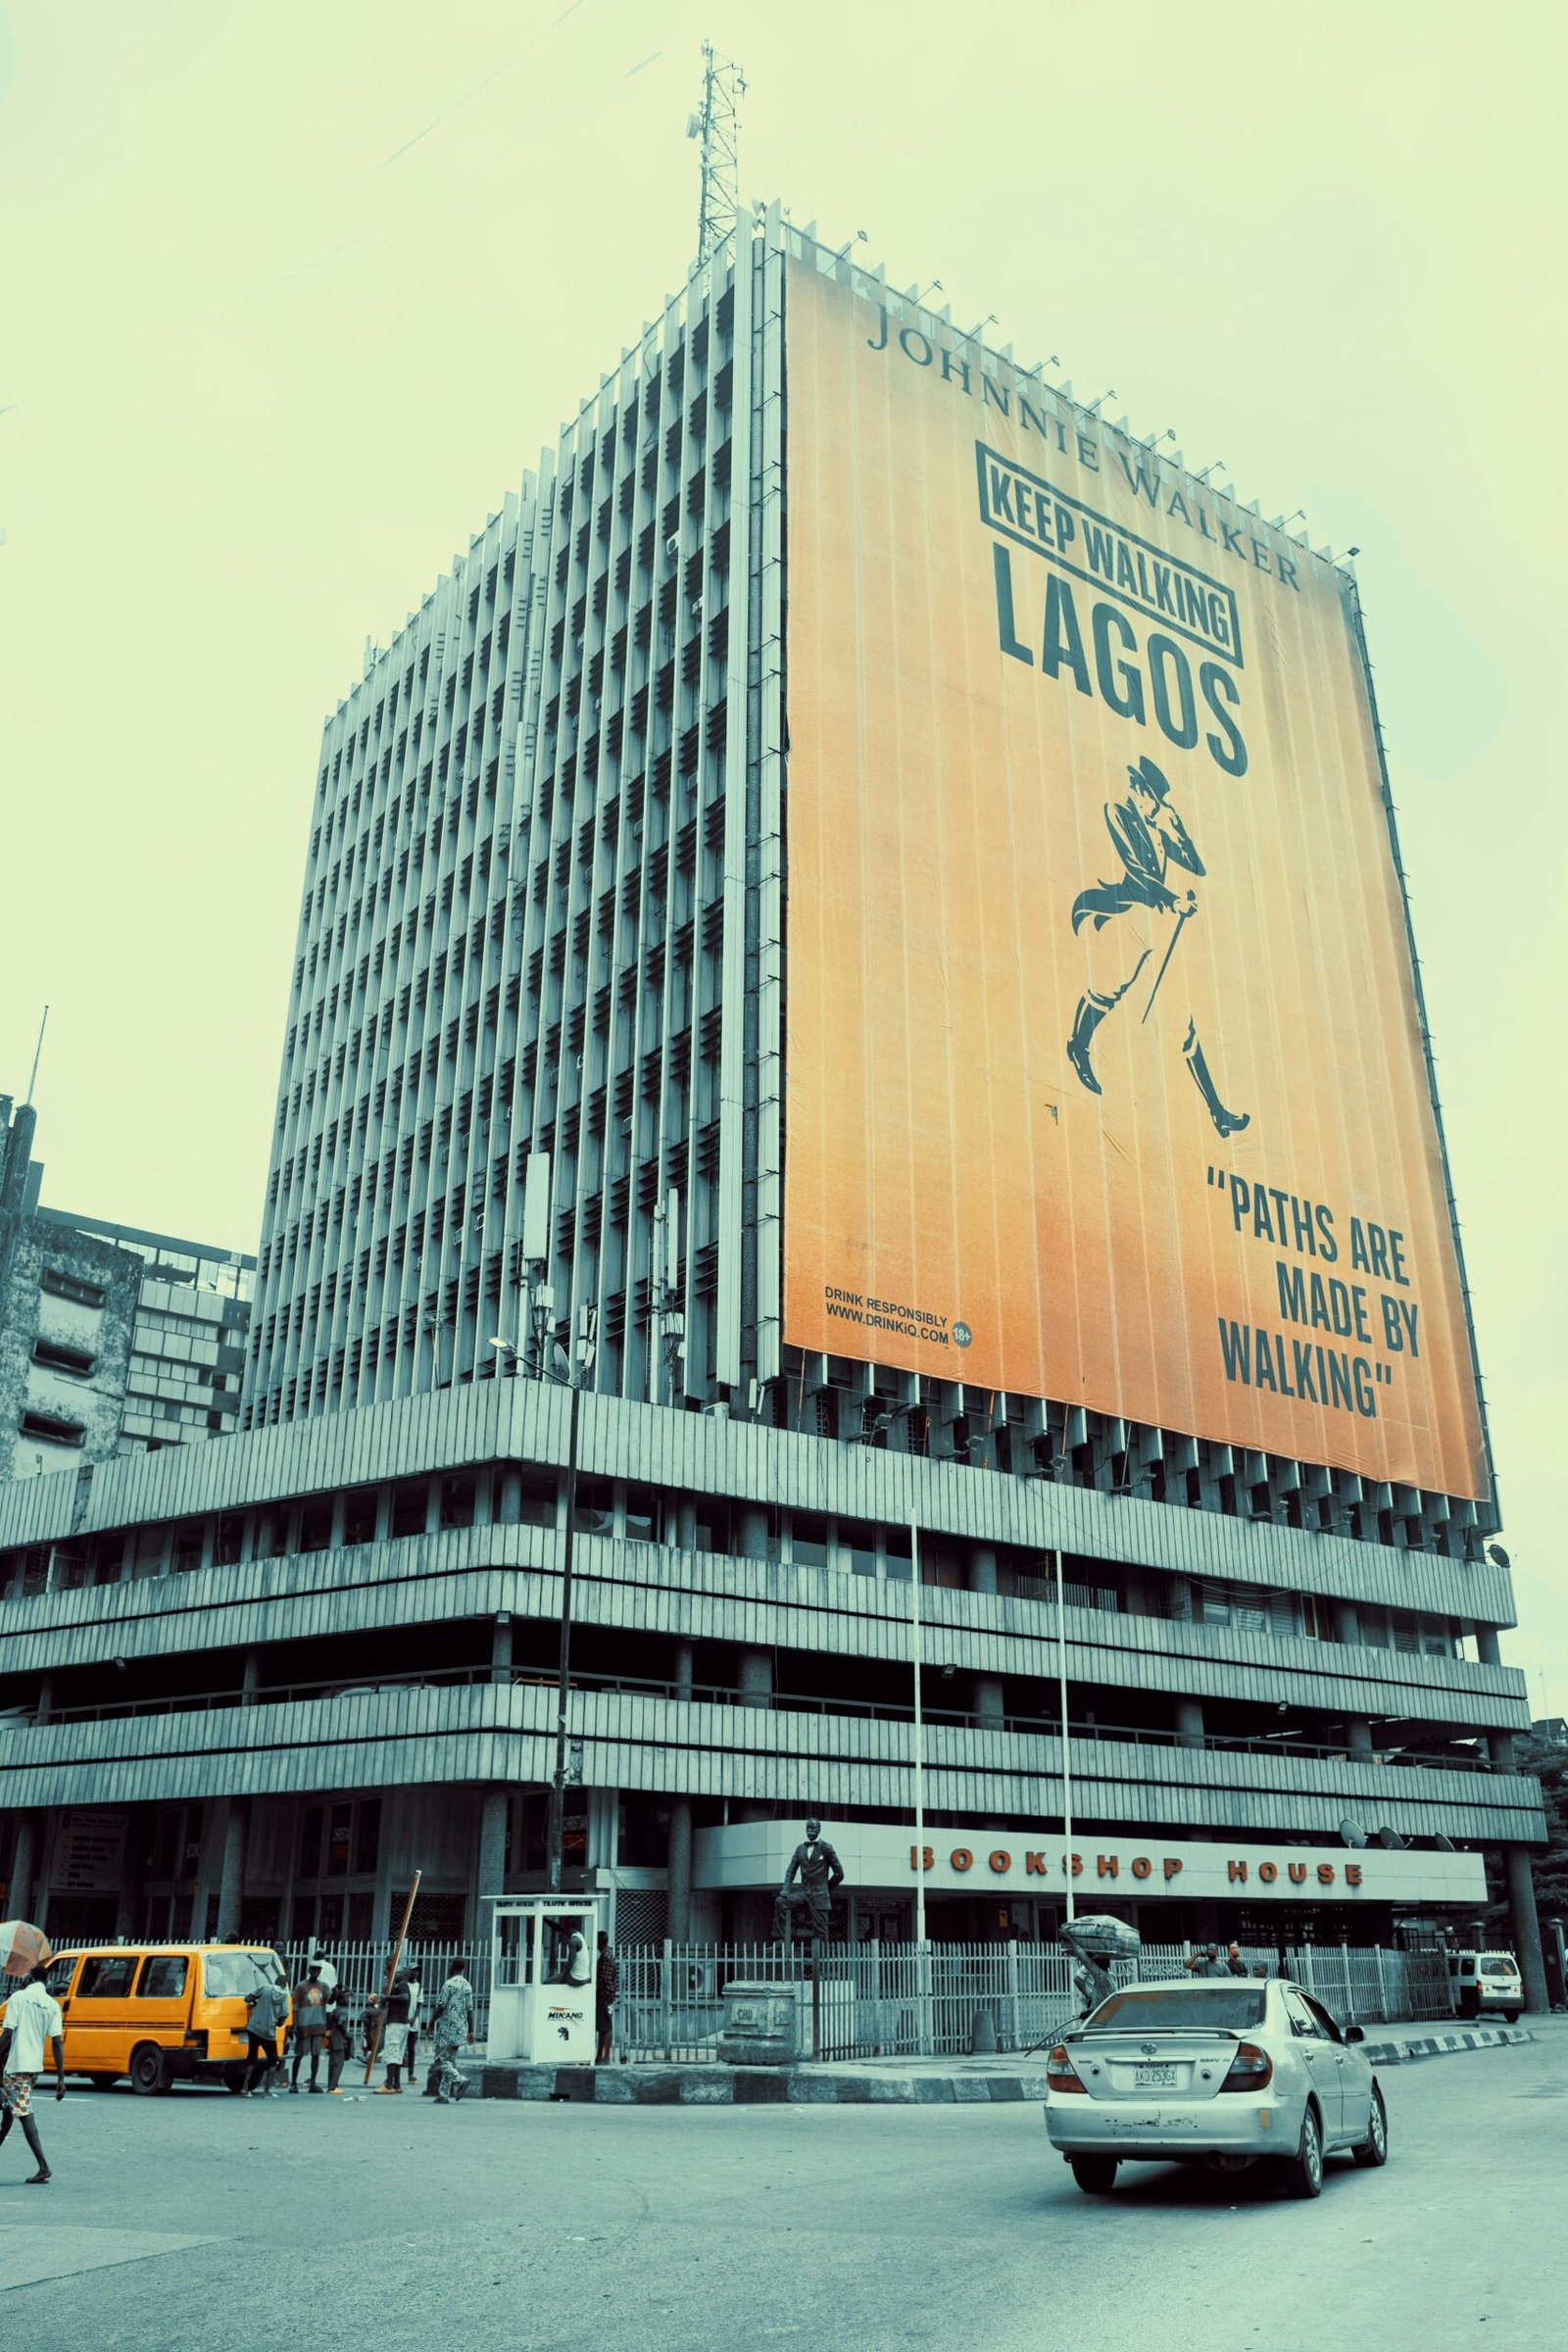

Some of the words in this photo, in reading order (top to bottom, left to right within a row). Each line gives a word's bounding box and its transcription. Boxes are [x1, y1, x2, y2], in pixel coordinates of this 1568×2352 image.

[866, 302, 1100, 472] JOHNNIE
[1118, 451, 1301, 592] WALKER
[990, 463, 1075, 555] KEEP
[1081, 519, 1230, 647] WALKING
[993, 541, 1249, 778] LAGOS
[1206, 1165, 1338, 1262] "PATHS
[1349, 1216, 1411, 1287] ARE
[825, 1286, 863, 1307] DRINK
[866, 1298, 948, 1328] RESPONSIBLY
[953, 1327, 971, 1342] 18+
[1275, 1260, 1372, 1346] MADE
[1380, 1294, 1419, 1357] BY
[1217, 1317, 1393, 1418] WALKING"
[910, 1845, 1184, 1880] BOOKSHOP
[1227, 1860, 1364, 1886] HOUSE
